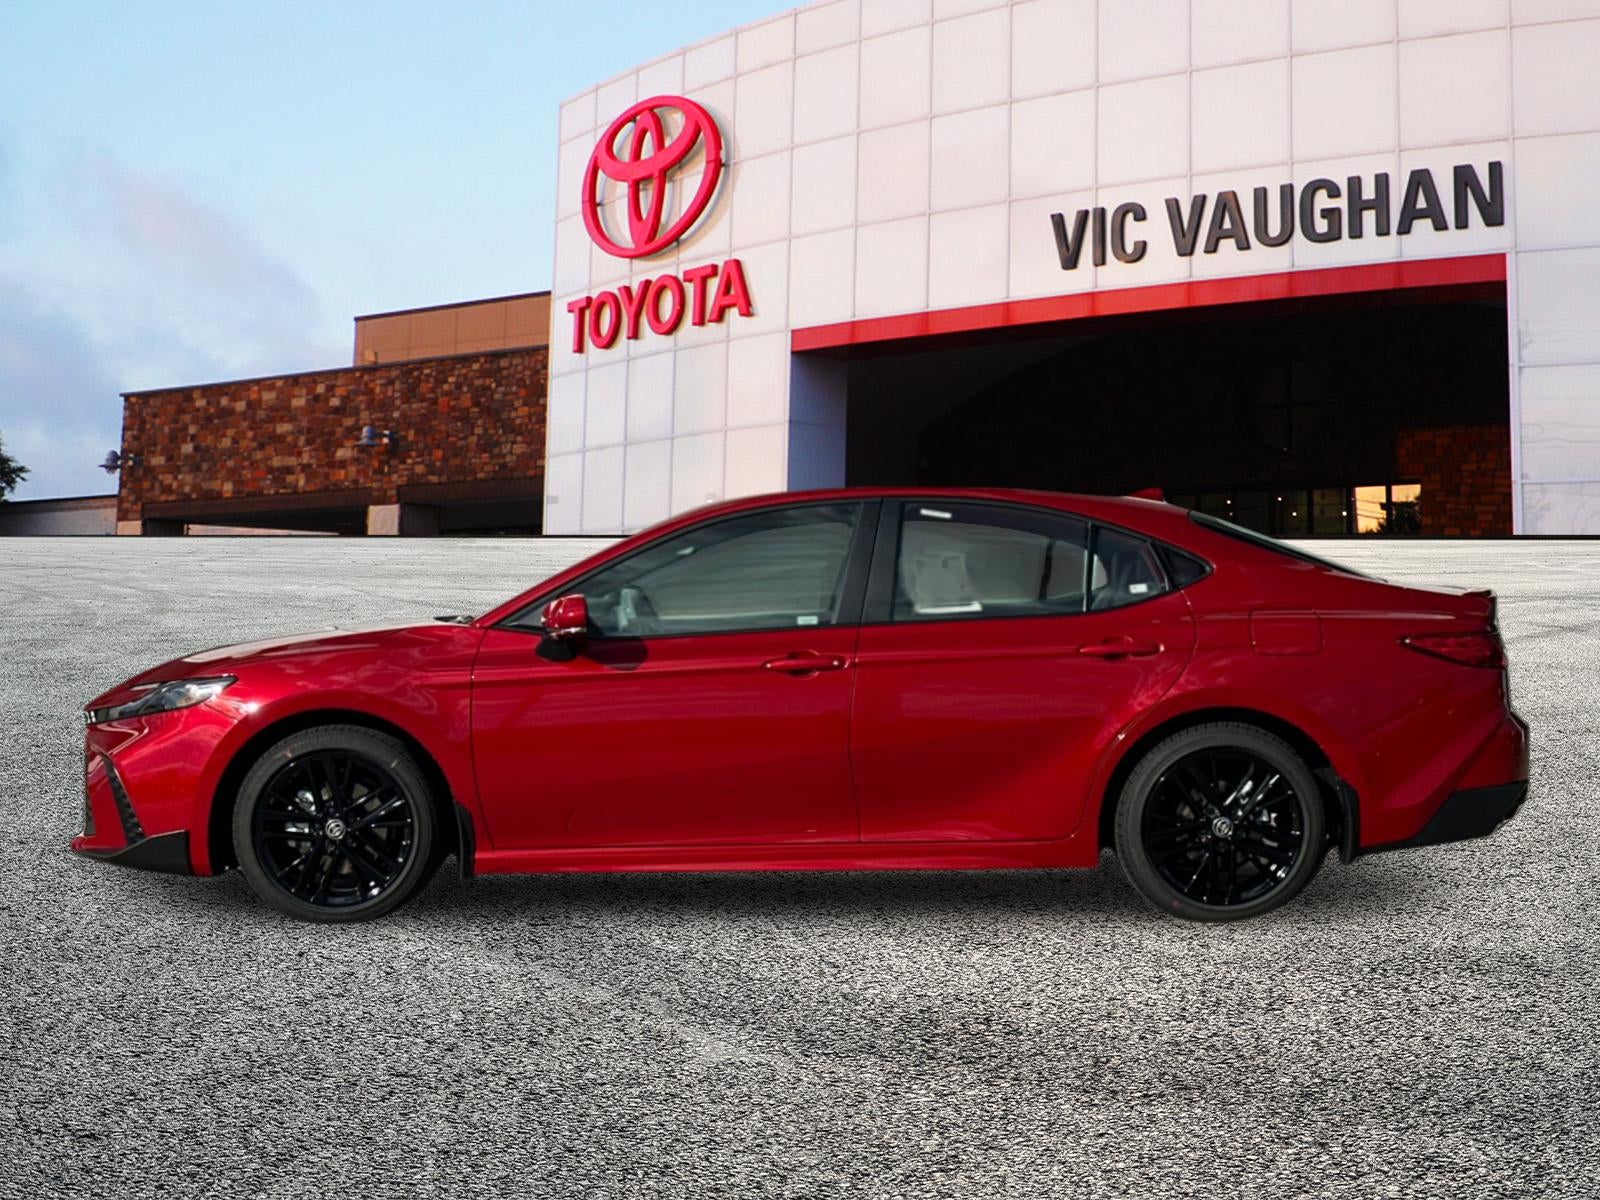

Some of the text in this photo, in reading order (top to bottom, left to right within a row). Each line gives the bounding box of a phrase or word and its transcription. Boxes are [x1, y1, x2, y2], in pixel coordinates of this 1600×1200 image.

[1050, 160, 1505, 270] VIC VAUGHAN
[567, 259, 754, 353] TOYOTA
